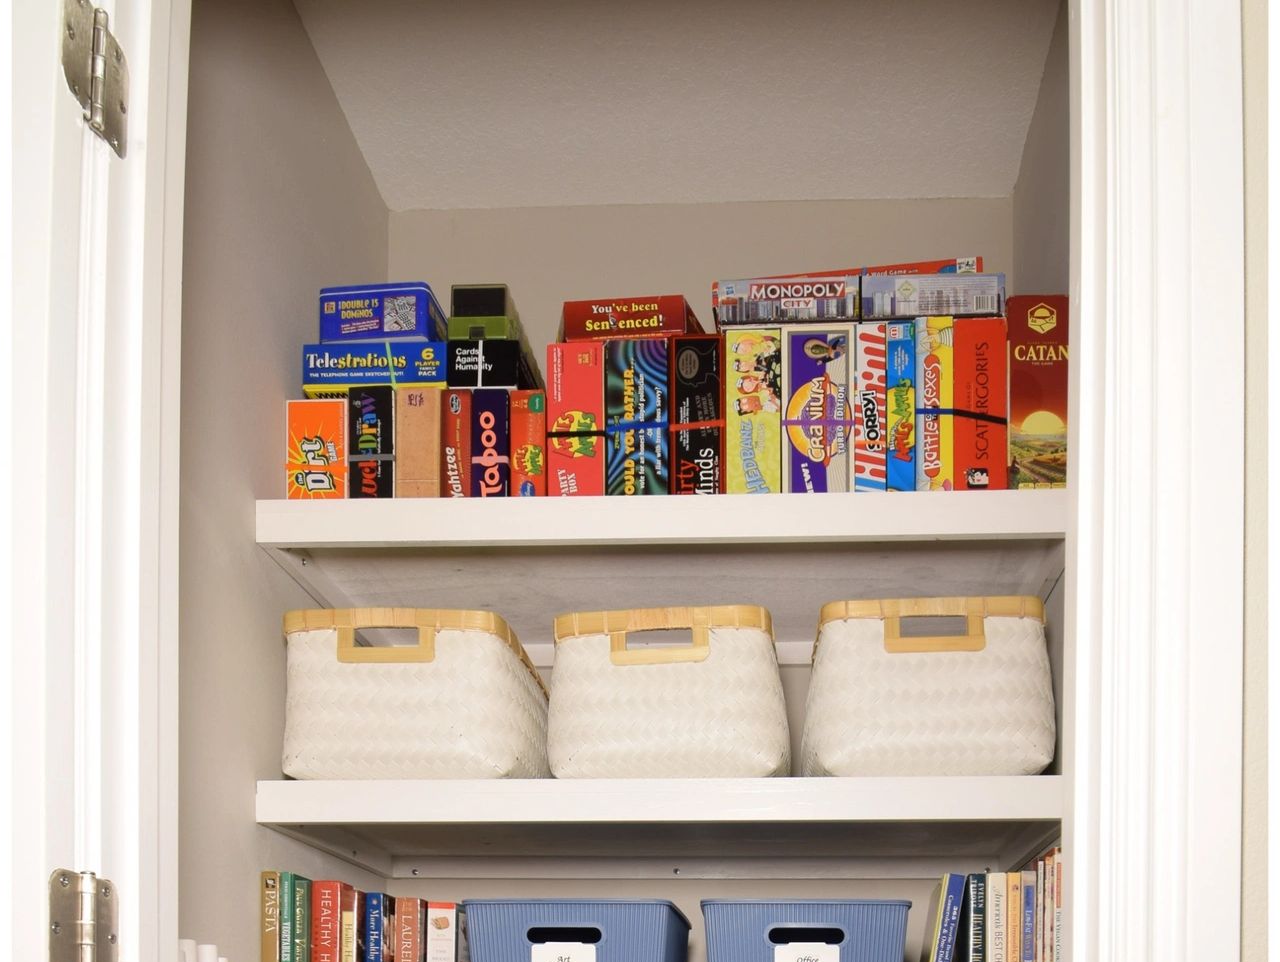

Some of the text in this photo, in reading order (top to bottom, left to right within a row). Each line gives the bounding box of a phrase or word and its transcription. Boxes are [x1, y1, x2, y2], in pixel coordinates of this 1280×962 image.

[750, 281, 845, 300] MONOPOLY
[782, 299, 813, 308] CITY
[591, 302, 659, 314] You've been
[421, 347, 435, 361] 6
[455, 347, 479, 355] Cards
[455, 355, 485, 364] Againt
[358, 391, 378, 450] Draw
[836, 385, 845, 454] TURBO EDITION
[300, 437, 335, 492] Drt
[479, 411, 503, 497] Taboo
[623, 459, 635, 495] OULD
[677, 459, 699, 495] irty
[977, 882, 985, 908] EVELYN
[265, 888, 277, 933] PASTA
[320, 889, 332, 948] HEALTHY
[370, 908, 379, 930] More
[369, 930, 379, 961] Healthy
[972, 913, 984, 950] HEALTHY
[994, 931, 1003, 951] BEST
[557, 955, 571, 962] Art
